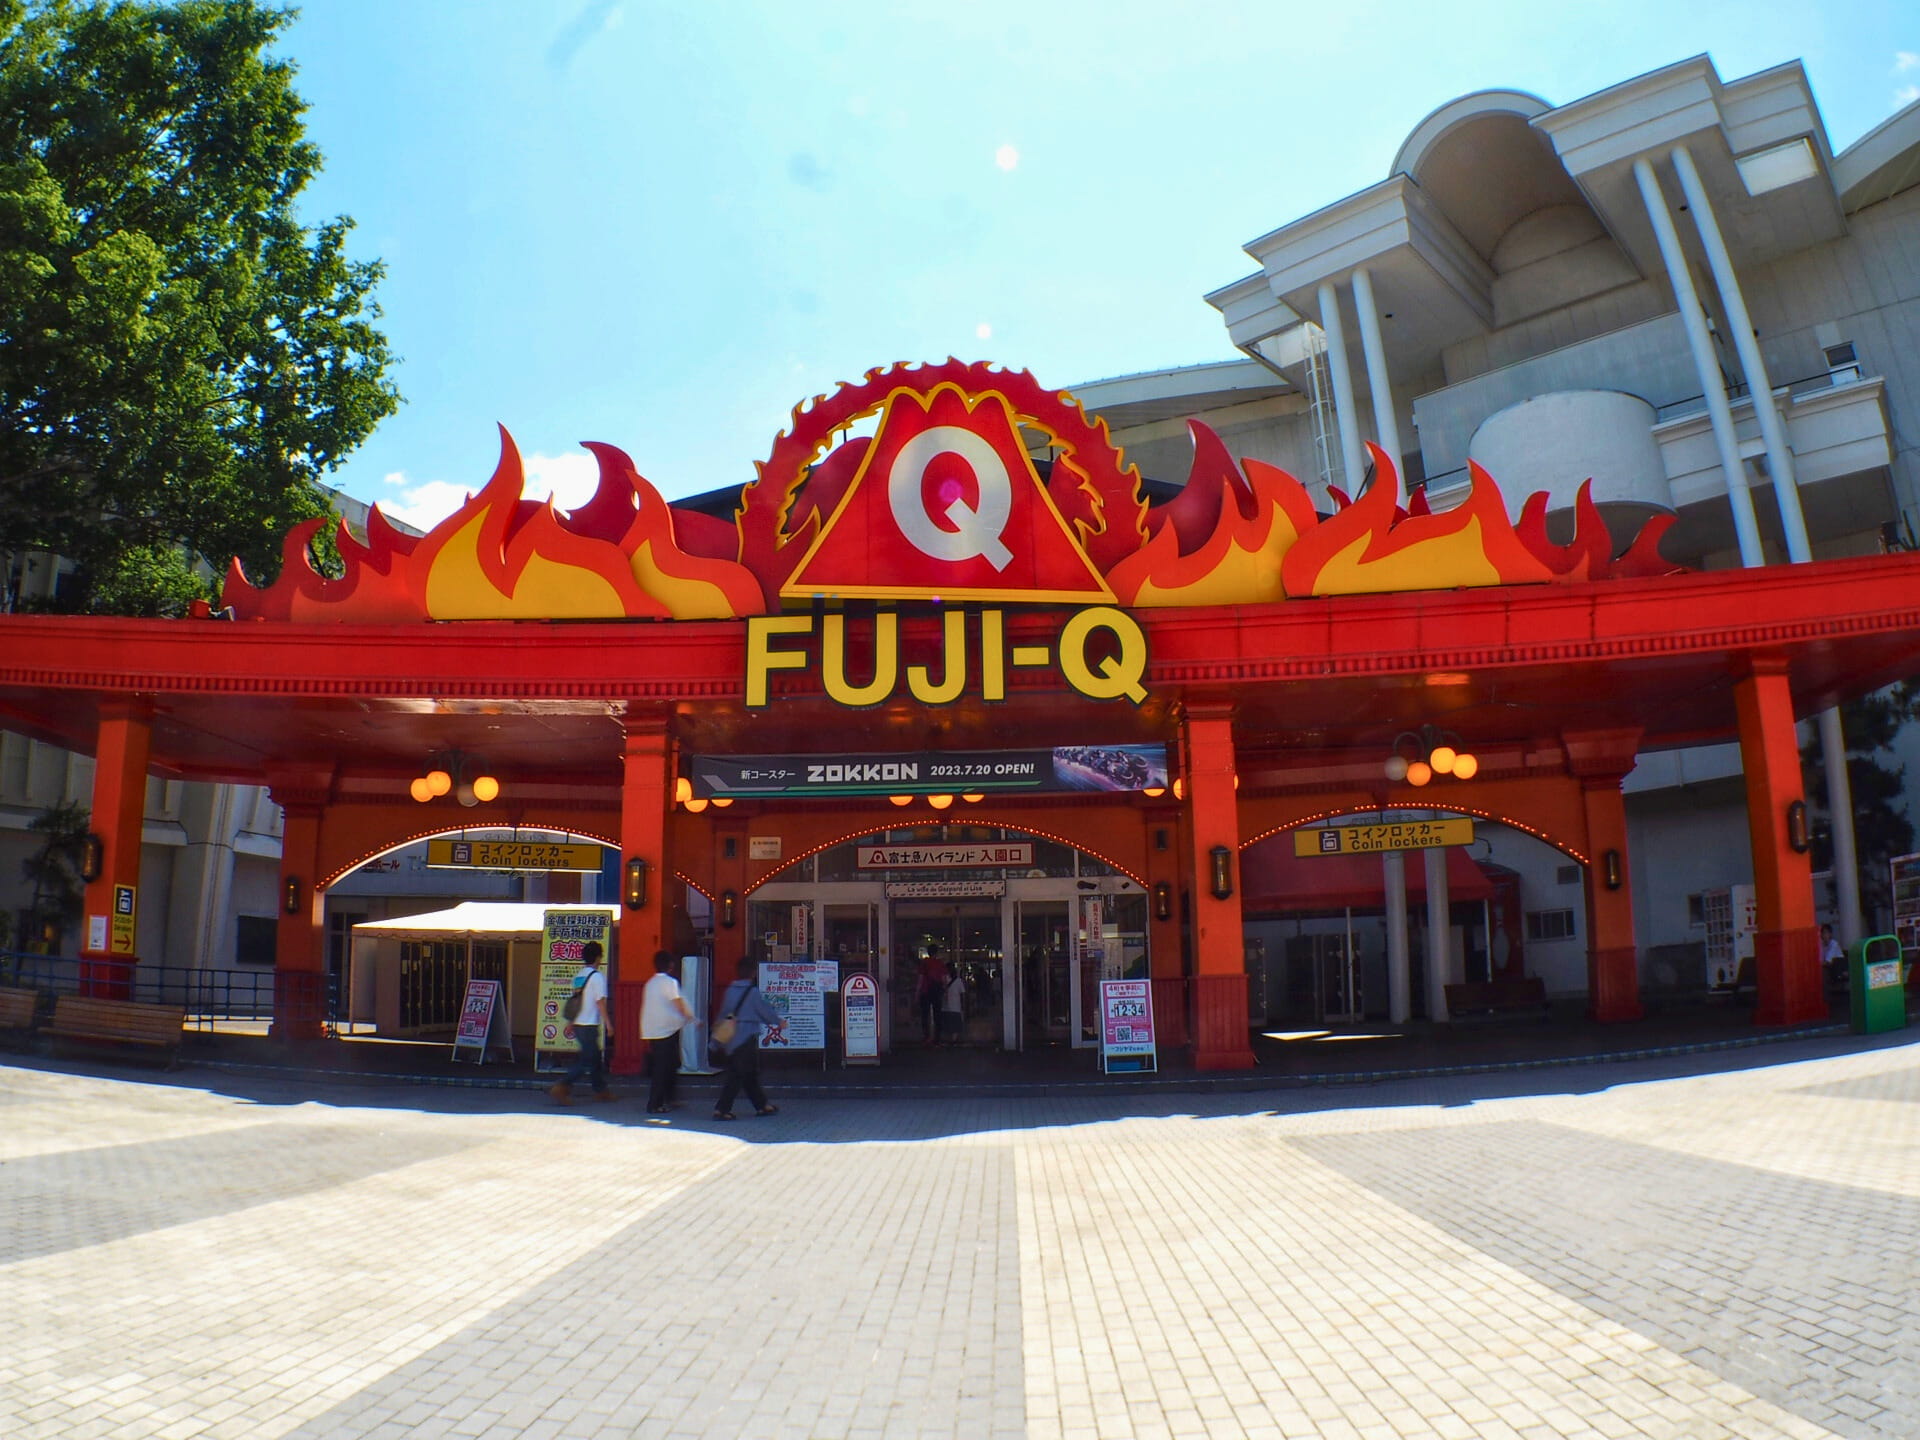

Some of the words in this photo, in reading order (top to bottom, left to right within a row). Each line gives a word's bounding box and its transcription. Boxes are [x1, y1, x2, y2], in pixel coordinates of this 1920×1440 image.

[888, 425, 1014, 573] Q
[745, 606, 1149, 706] FUJI-Q
[740, 769, 796, 780] 新コースター
[806, 762, 919, 782] ZOKKON
[930, 763, 992, 776] 2023.7.20
[993, 762, 1035, 775] OPEN!
[1348, 823, 1446, 840] コインロッカー
[479, 844, 574, 856] コインロッカー
[1351, 838, 1383, 851] Coin
[1389, 834, 1442, 848] lockers
[481, 854, 512, 865] Coin
[518, 855, 569, 867] lockers
[888, 850, 975, 864] 富士急ハイランド
[979, 848, 1022, 862] 入園口
[547, 914, 609, 926] 金属探知検査
[548, 927, 604, 939] 手荷物確認
[550, 941, 585, 960] 実施
